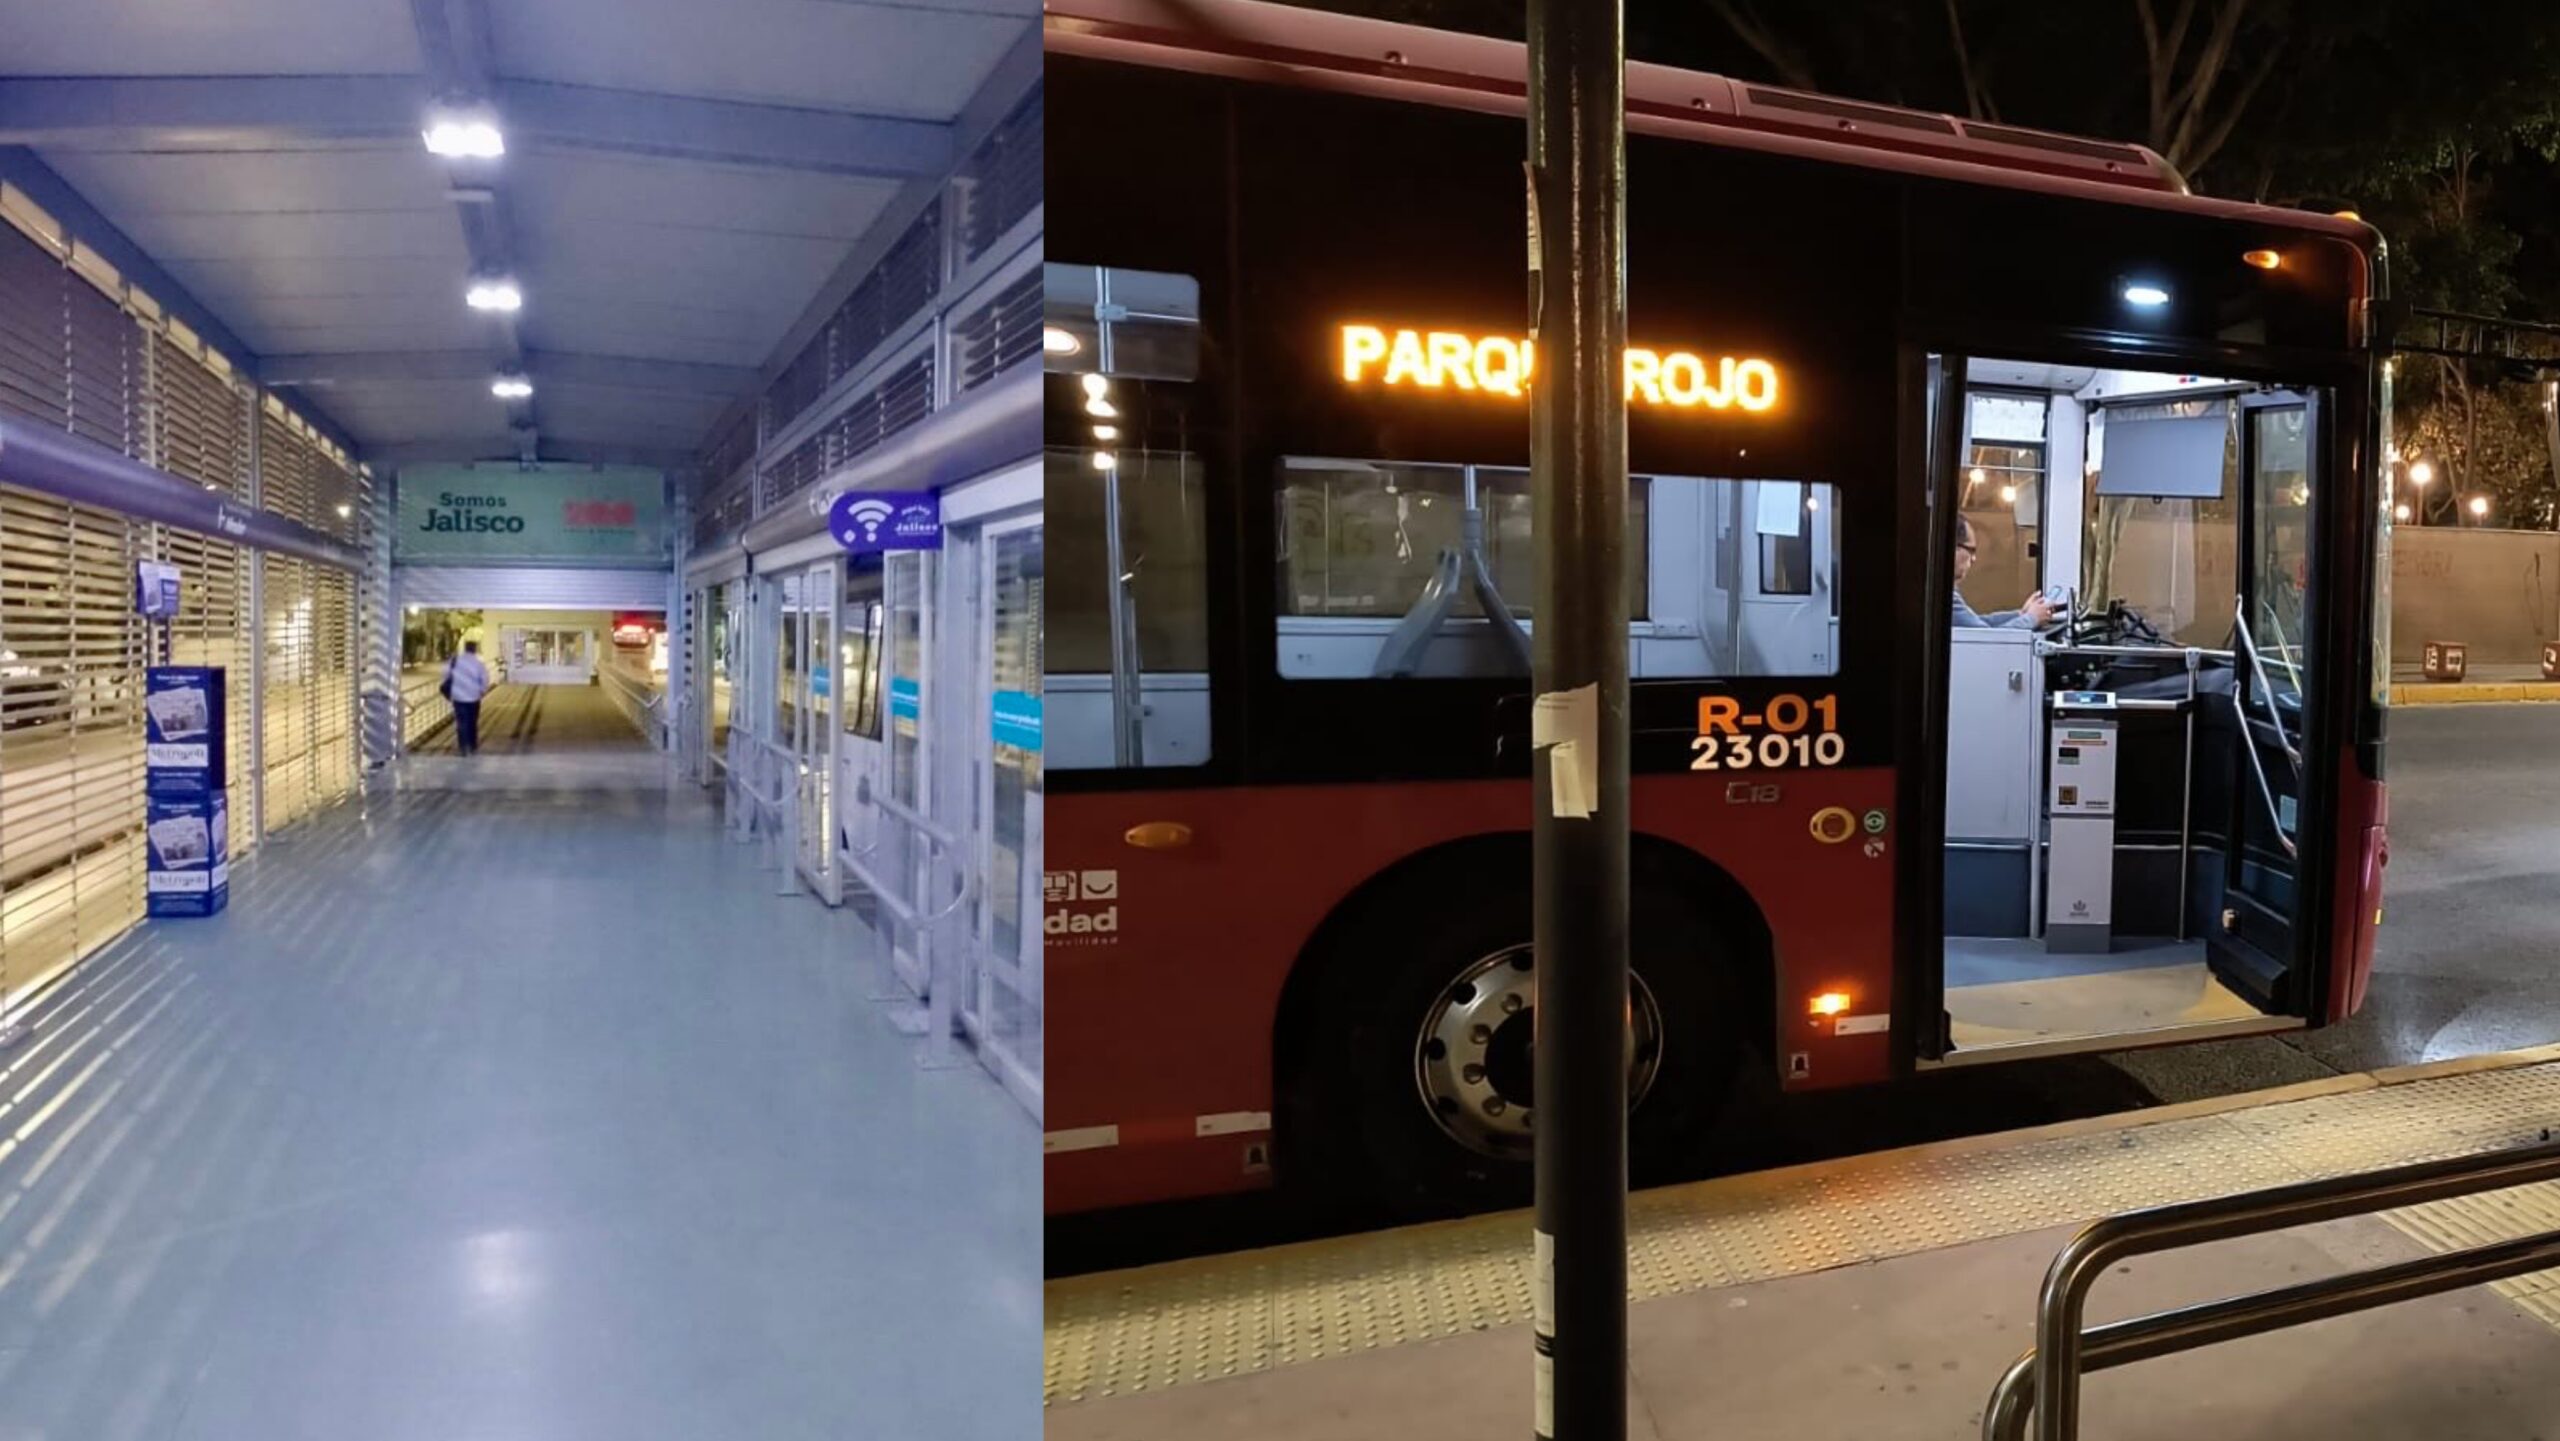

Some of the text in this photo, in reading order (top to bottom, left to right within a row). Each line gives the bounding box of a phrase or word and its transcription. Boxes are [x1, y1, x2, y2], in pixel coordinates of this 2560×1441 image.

[1623, 347, 1778, 411] ROJO
[439, 491, 507, 508] Somos
[419, 508, 525, 533] Jalisco
[1690, 732, 1845, 769] 23010
[1726, 781, 1781, 803] C18
[1043, 906, 1117, 934] dad
